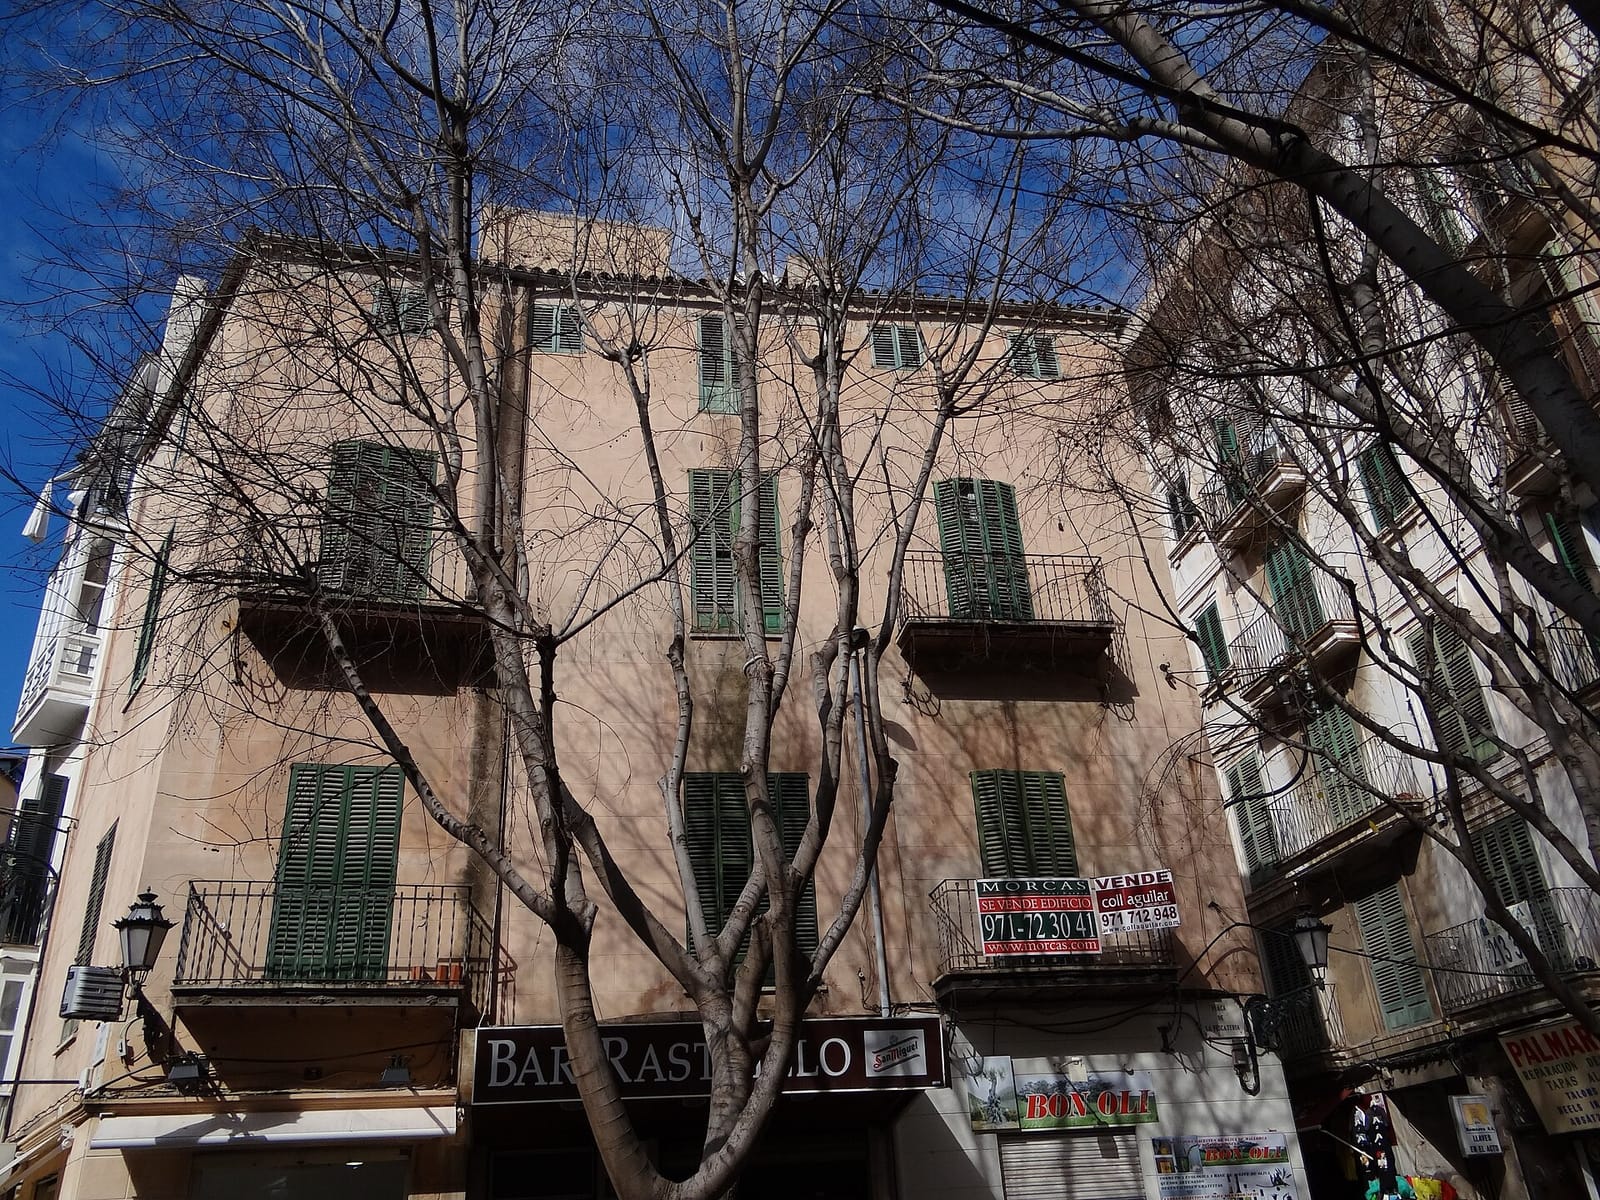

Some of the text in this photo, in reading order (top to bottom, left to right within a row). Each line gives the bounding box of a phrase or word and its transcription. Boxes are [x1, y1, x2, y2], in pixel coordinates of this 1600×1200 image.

[982, 881, 1087, 892] MORCAS
[1095, 871, 1170, 889] VENDE
[981, 898, 1091, 911] SE VENDE EDIFICIO
[1102, 890, 1168, 908] coll aguilar
[1102, 906, 1177, 926] 971 712 948
[1049, 912, 1071, 938] 30
[1076, 912, 1096, 938] 41
[1103, 920, 1180, 933] www.collaguilar.com
[988, 941, 1098, 953] www.morcas.com
[488, 1036, 851, 1087] BAR RASTLO
[1546, 1076, 1578, 1091] TAPAS
[1025, 1089, 1152, 1120] BON OLI
[1205, 1145, 1281, 1162] BON OLI
